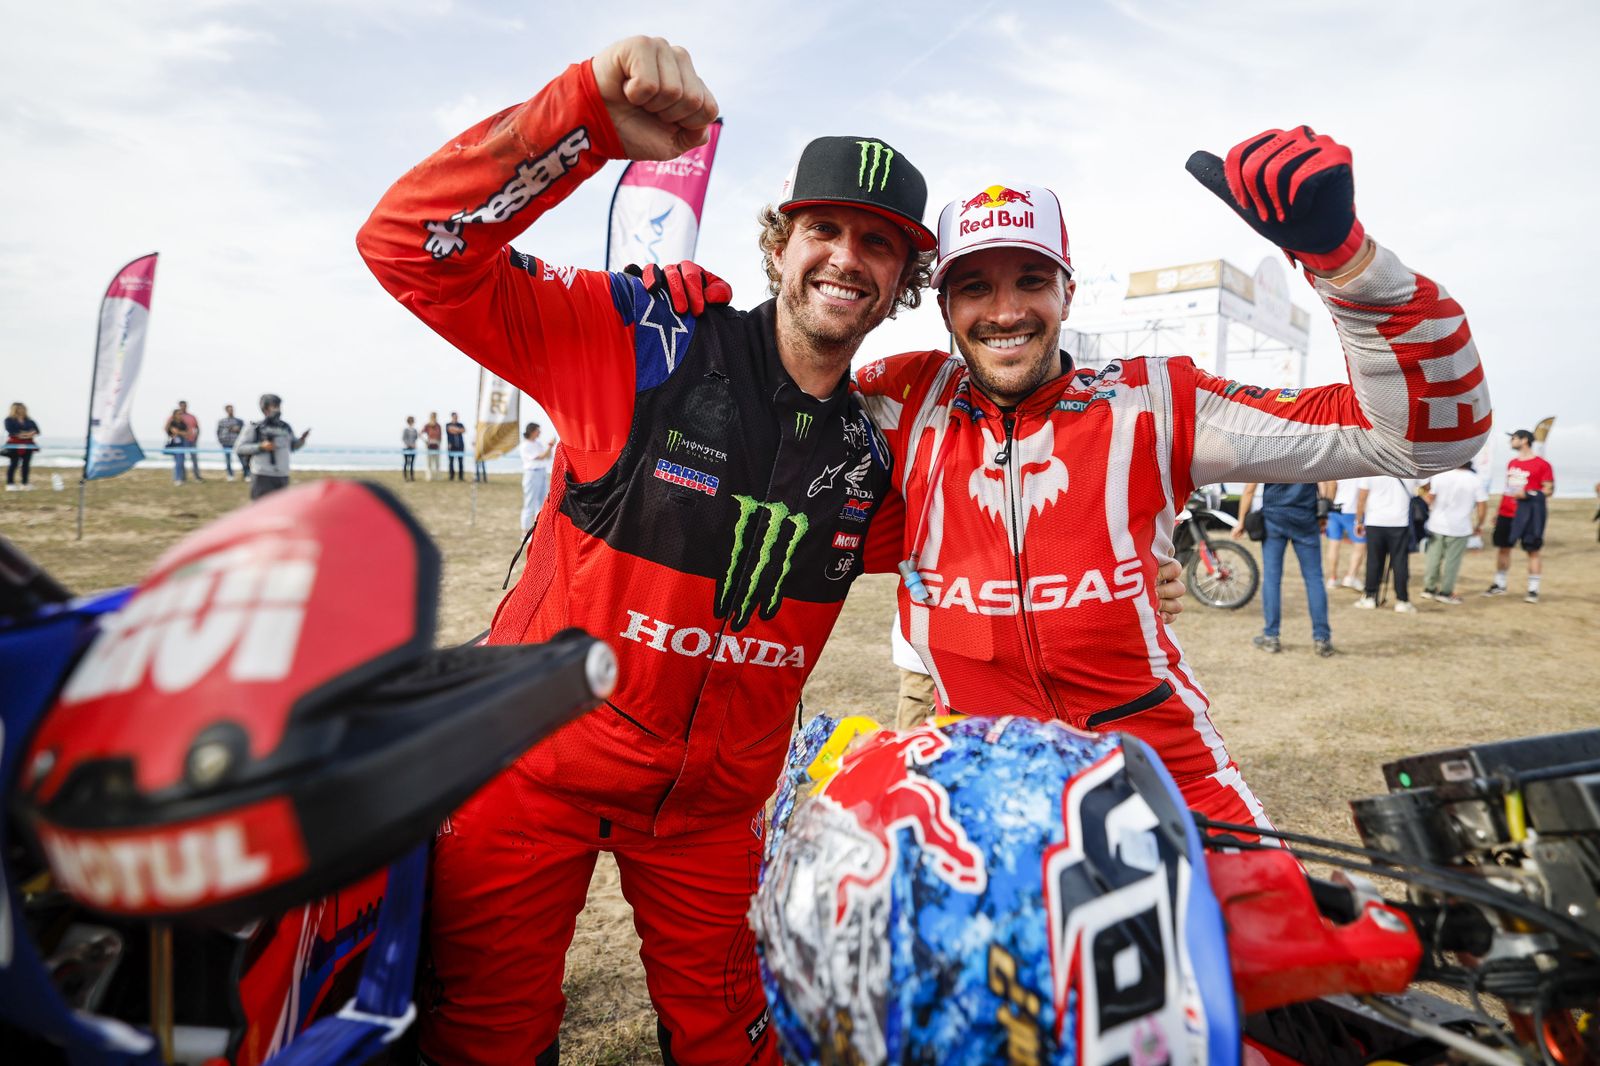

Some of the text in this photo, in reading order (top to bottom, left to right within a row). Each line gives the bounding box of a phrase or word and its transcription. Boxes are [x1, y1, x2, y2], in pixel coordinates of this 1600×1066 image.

[960, 210, 1034, 237] Red Bull
[681, 439, 728, 462] MONSTER
[653, 469, 717, 497] EUROPE
[656, 458, 719, 488] PARTS
[909, 559, 1144, 617] GASGAS
[619, 609, 805, 668] HONDA
